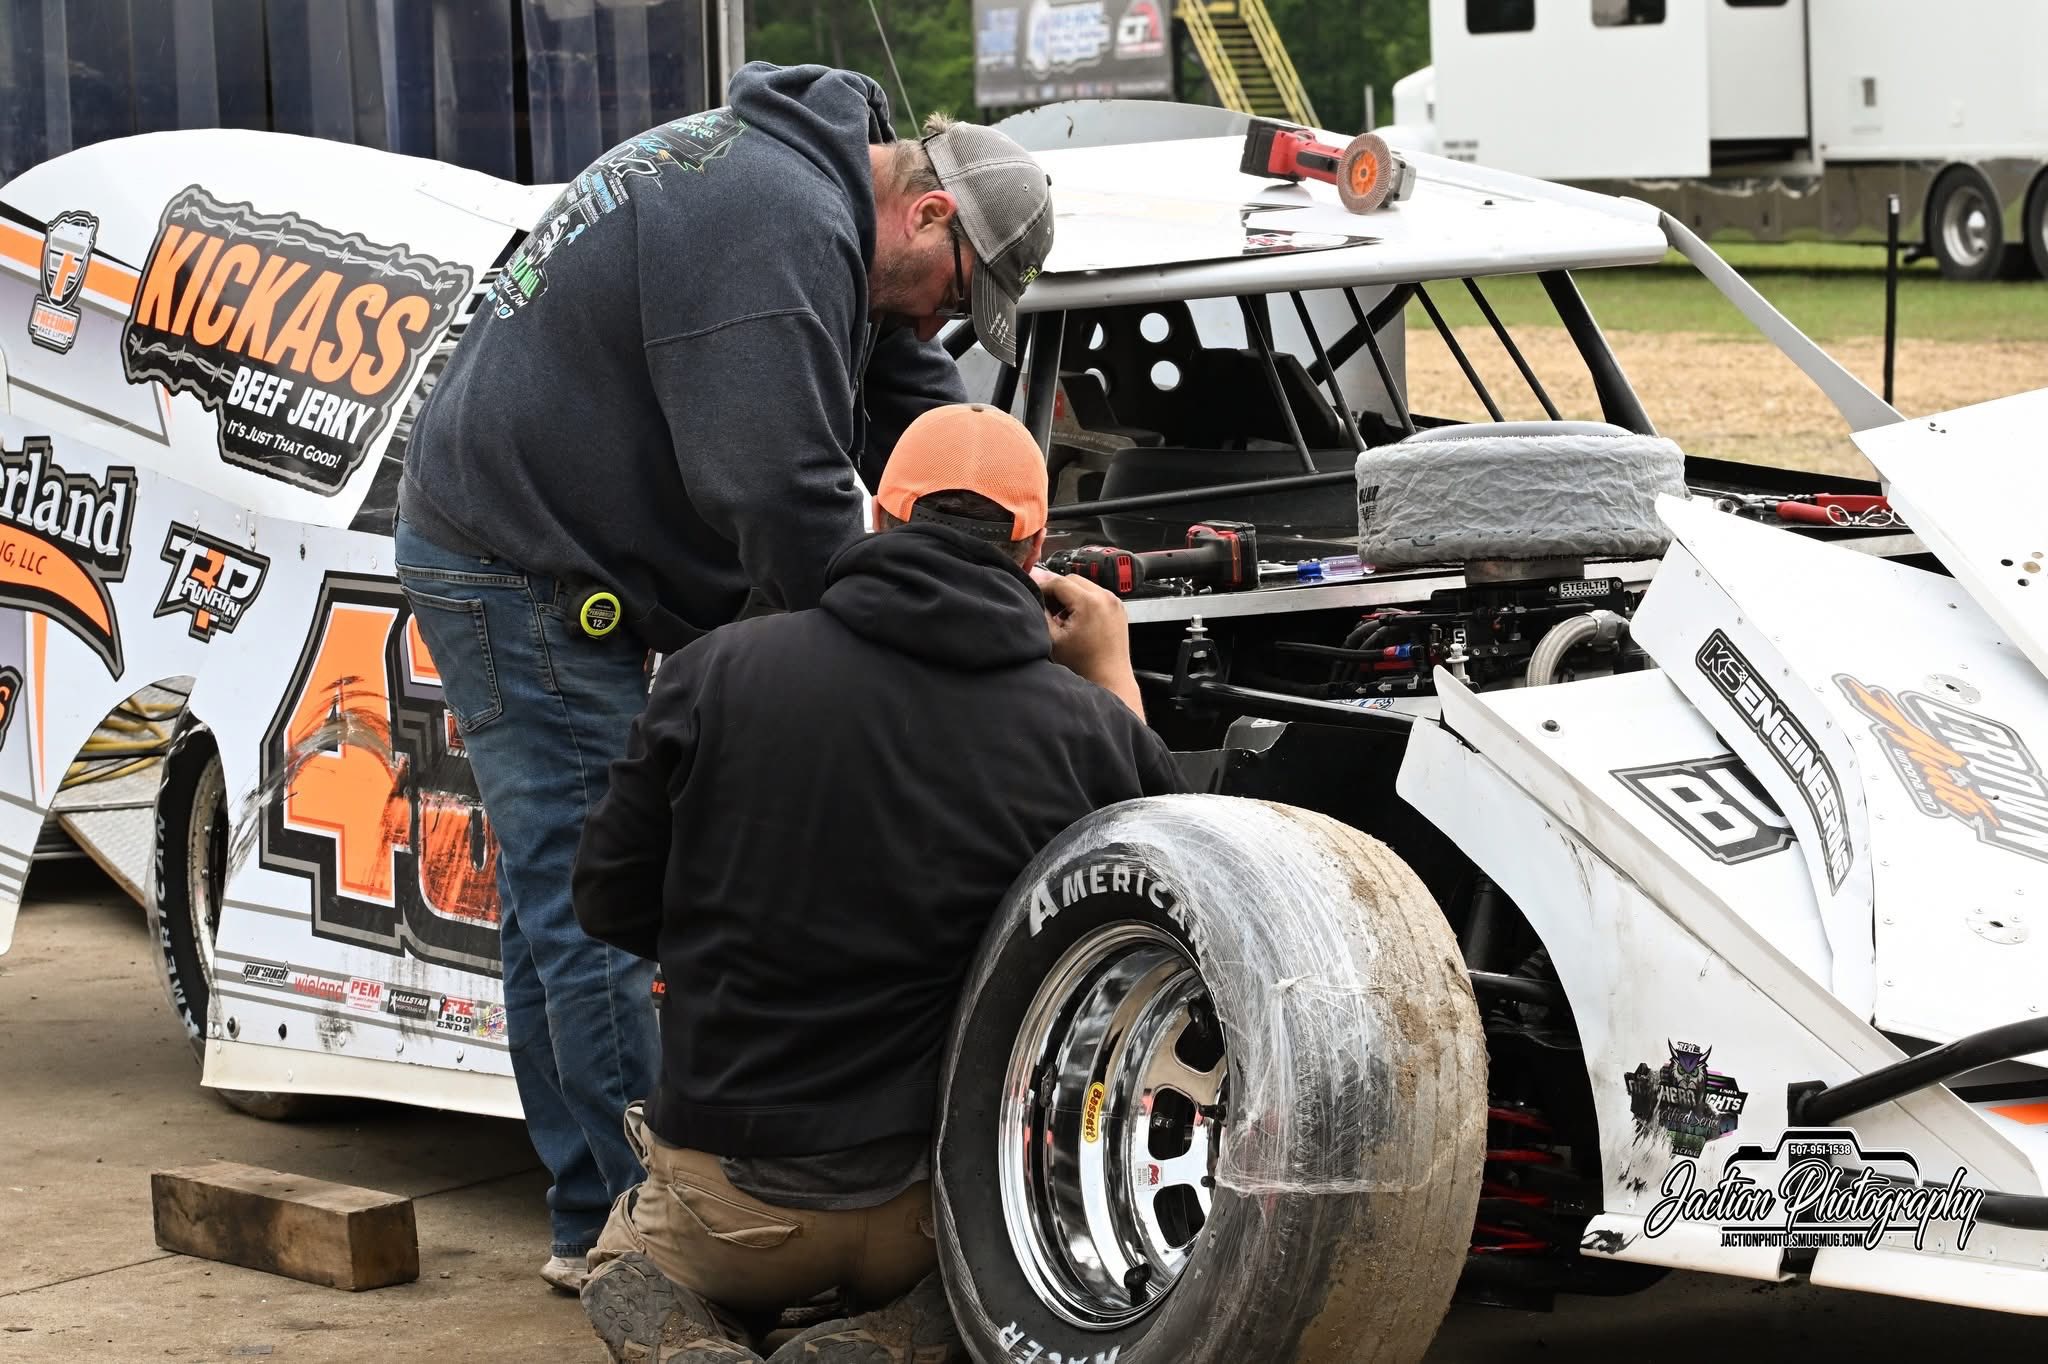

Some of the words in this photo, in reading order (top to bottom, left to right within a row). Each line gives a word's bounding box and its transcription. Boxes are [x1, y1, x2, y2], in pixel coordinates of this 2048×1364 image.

[137, 224, 431, 395] KICKASS
[227, 366, 294, 417] BEEF
[287, 387, 376, 444] JERKY
[227, 419, 247, 438] IT'S
[245, 426, 274, 446] JUST
[273, 434, 304, 456] THAT
[303, 445, 342, 468] GOOD!
[0, 452, 126, 556] rland
[19, 548, 47, 575] LLC
[1562, 580, 1607, 592] STEALTH
[592, 618, 603, 628] 12
[156, 814, 200, 1038] AMERICAN
[295, 974, 345, 1002] wieland
[351, 981, 381, 998] PEM
[397, 995, 428, 1007] ALLSTAR
[443, 998, 474, 1016] FK
[445, 1013, 472, 1025] ROD
[436, 1020, 470, 1033] ENDS
[1085, 1088, 1103, 1138] Bassett
